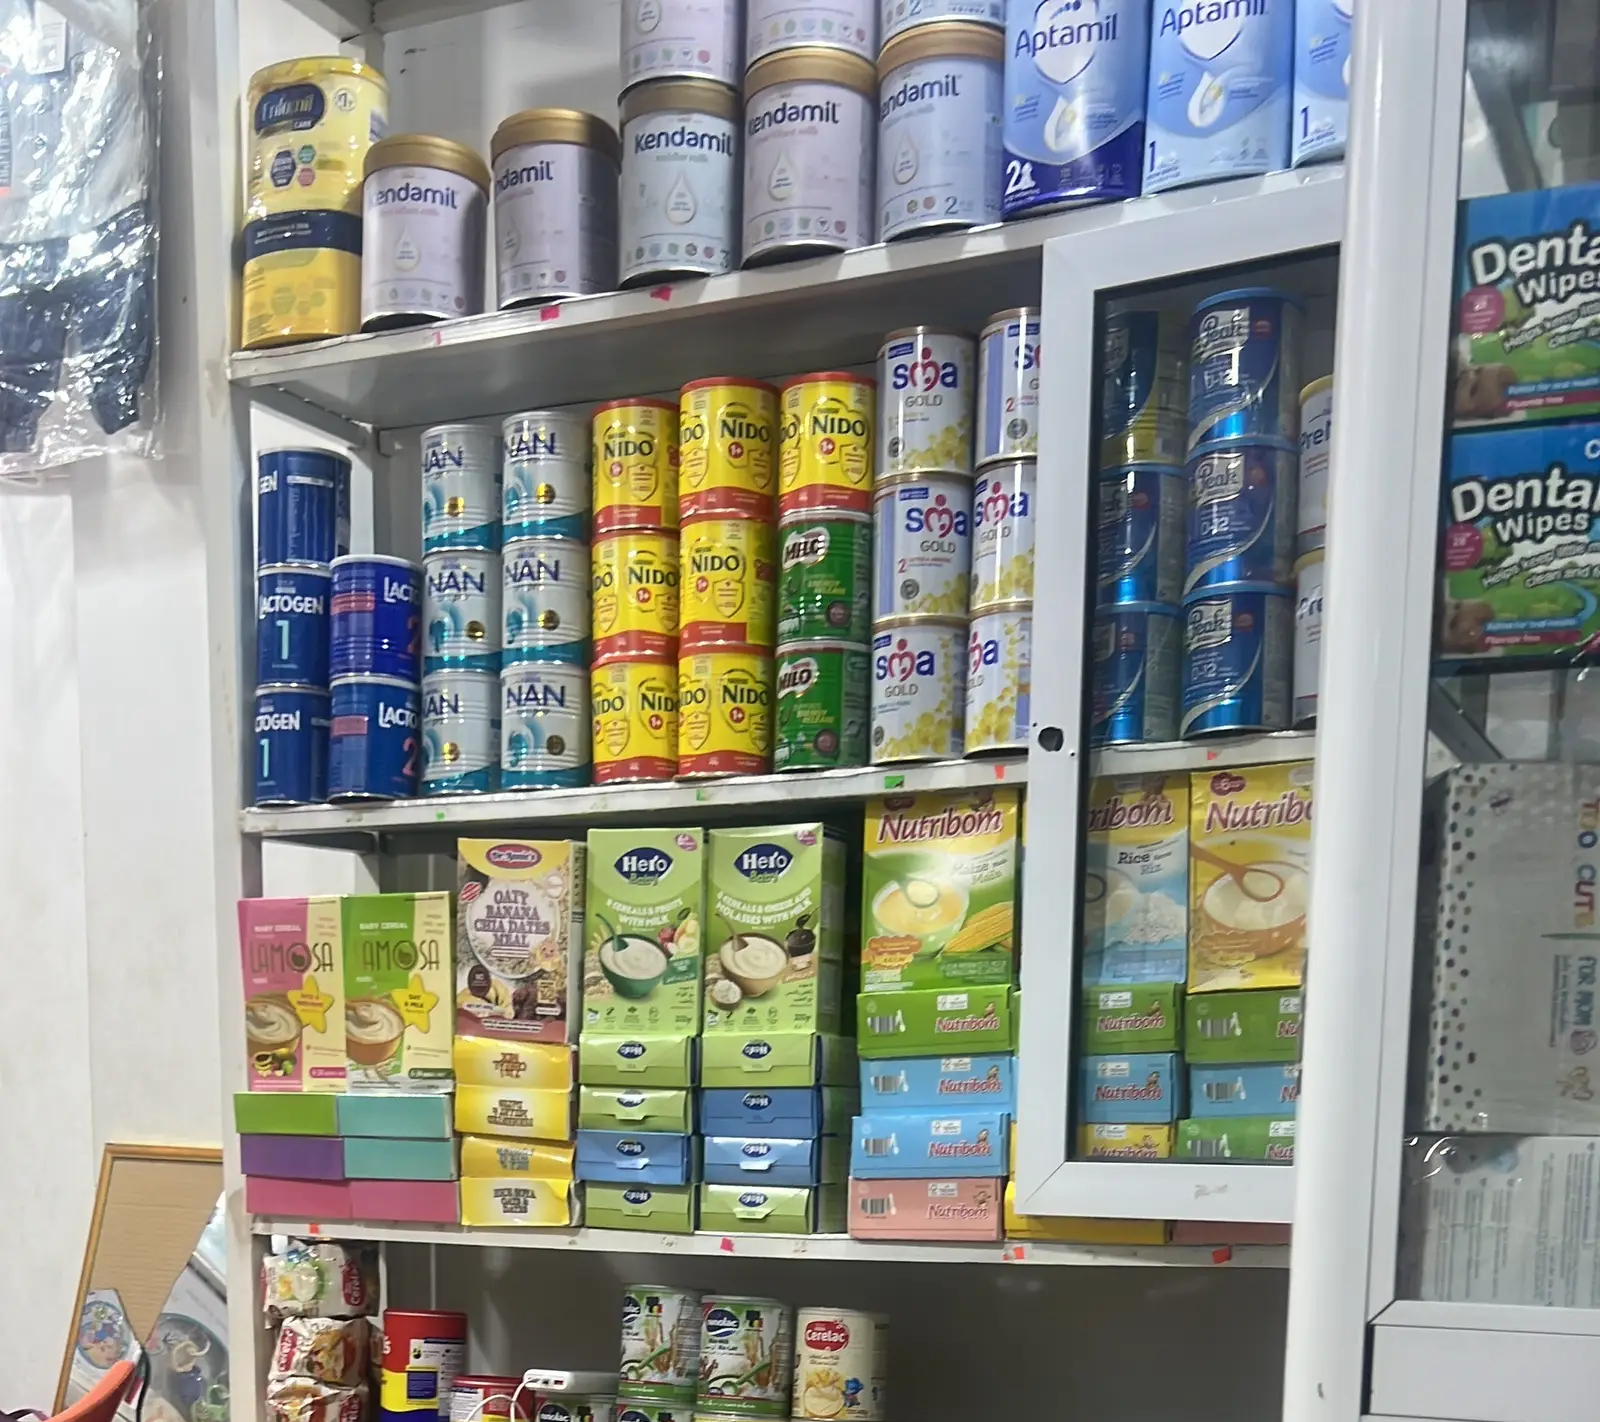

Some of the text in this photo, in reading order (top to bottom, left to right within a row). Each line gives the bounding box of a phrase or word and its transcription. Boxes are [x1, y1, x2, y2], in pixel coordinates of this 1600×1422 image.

[1014, 12, 1118, 59] Aptamil
[879, 75, 960, 122] endamil
[634, 125, 733, 157] Kendamil
[376, 182, 458, 210] endamil
[1517, 268, 1600, 305] Wipe
[905, 395, 943, 407] GOLD
[682, 423, 705, 444] DO
[720, 418, 771, 442] NIDO
[780, 420, 798, 443] DO
[811, 414, 866, 437] NIDO
[604, 439, 654, 461] NIDO
[1195, 461, 1239, 494] Peak
[1496, 511, 1590, 543] Wipes
[920, 540, 956, 554] GOLD
[691, 554, 740, 574] NIDO
[428, 570, 485, 594] NAN
[593, 571, 613, 591] DO
[628, 565, 678, 587] NIDO
[259, 594, 324, 620] LACTOGEN
[276, 620, 291, 659] 1
[507, 684, 565, 709] NAN
[722, 684, 769, 706] NIDO
[884, 684, 919, 698] GOLD
[424, 693, 459, 716] AN
[641, 692, 679, 713] NID
[260, 739, 269, 778] 1
[876, 807, 1004, 844] Nutribom
[622, 855, 668, 873] Hero
[742, 852, 788, 870] Hero
[1117, 851, 1150, 864] Rice
[494, 889, 529, 905] OATY
[485, 905, 540, 921] BANANA
[475, 919, 550, 935] CHIA DATES
[358, 940, 441, 972] AMOSA
[935, 1012, 1000, 1033] Nutribom
[927, 1202, 989, 1219] Nutribom
[806, 1329, 846, 1343] Cerelac
